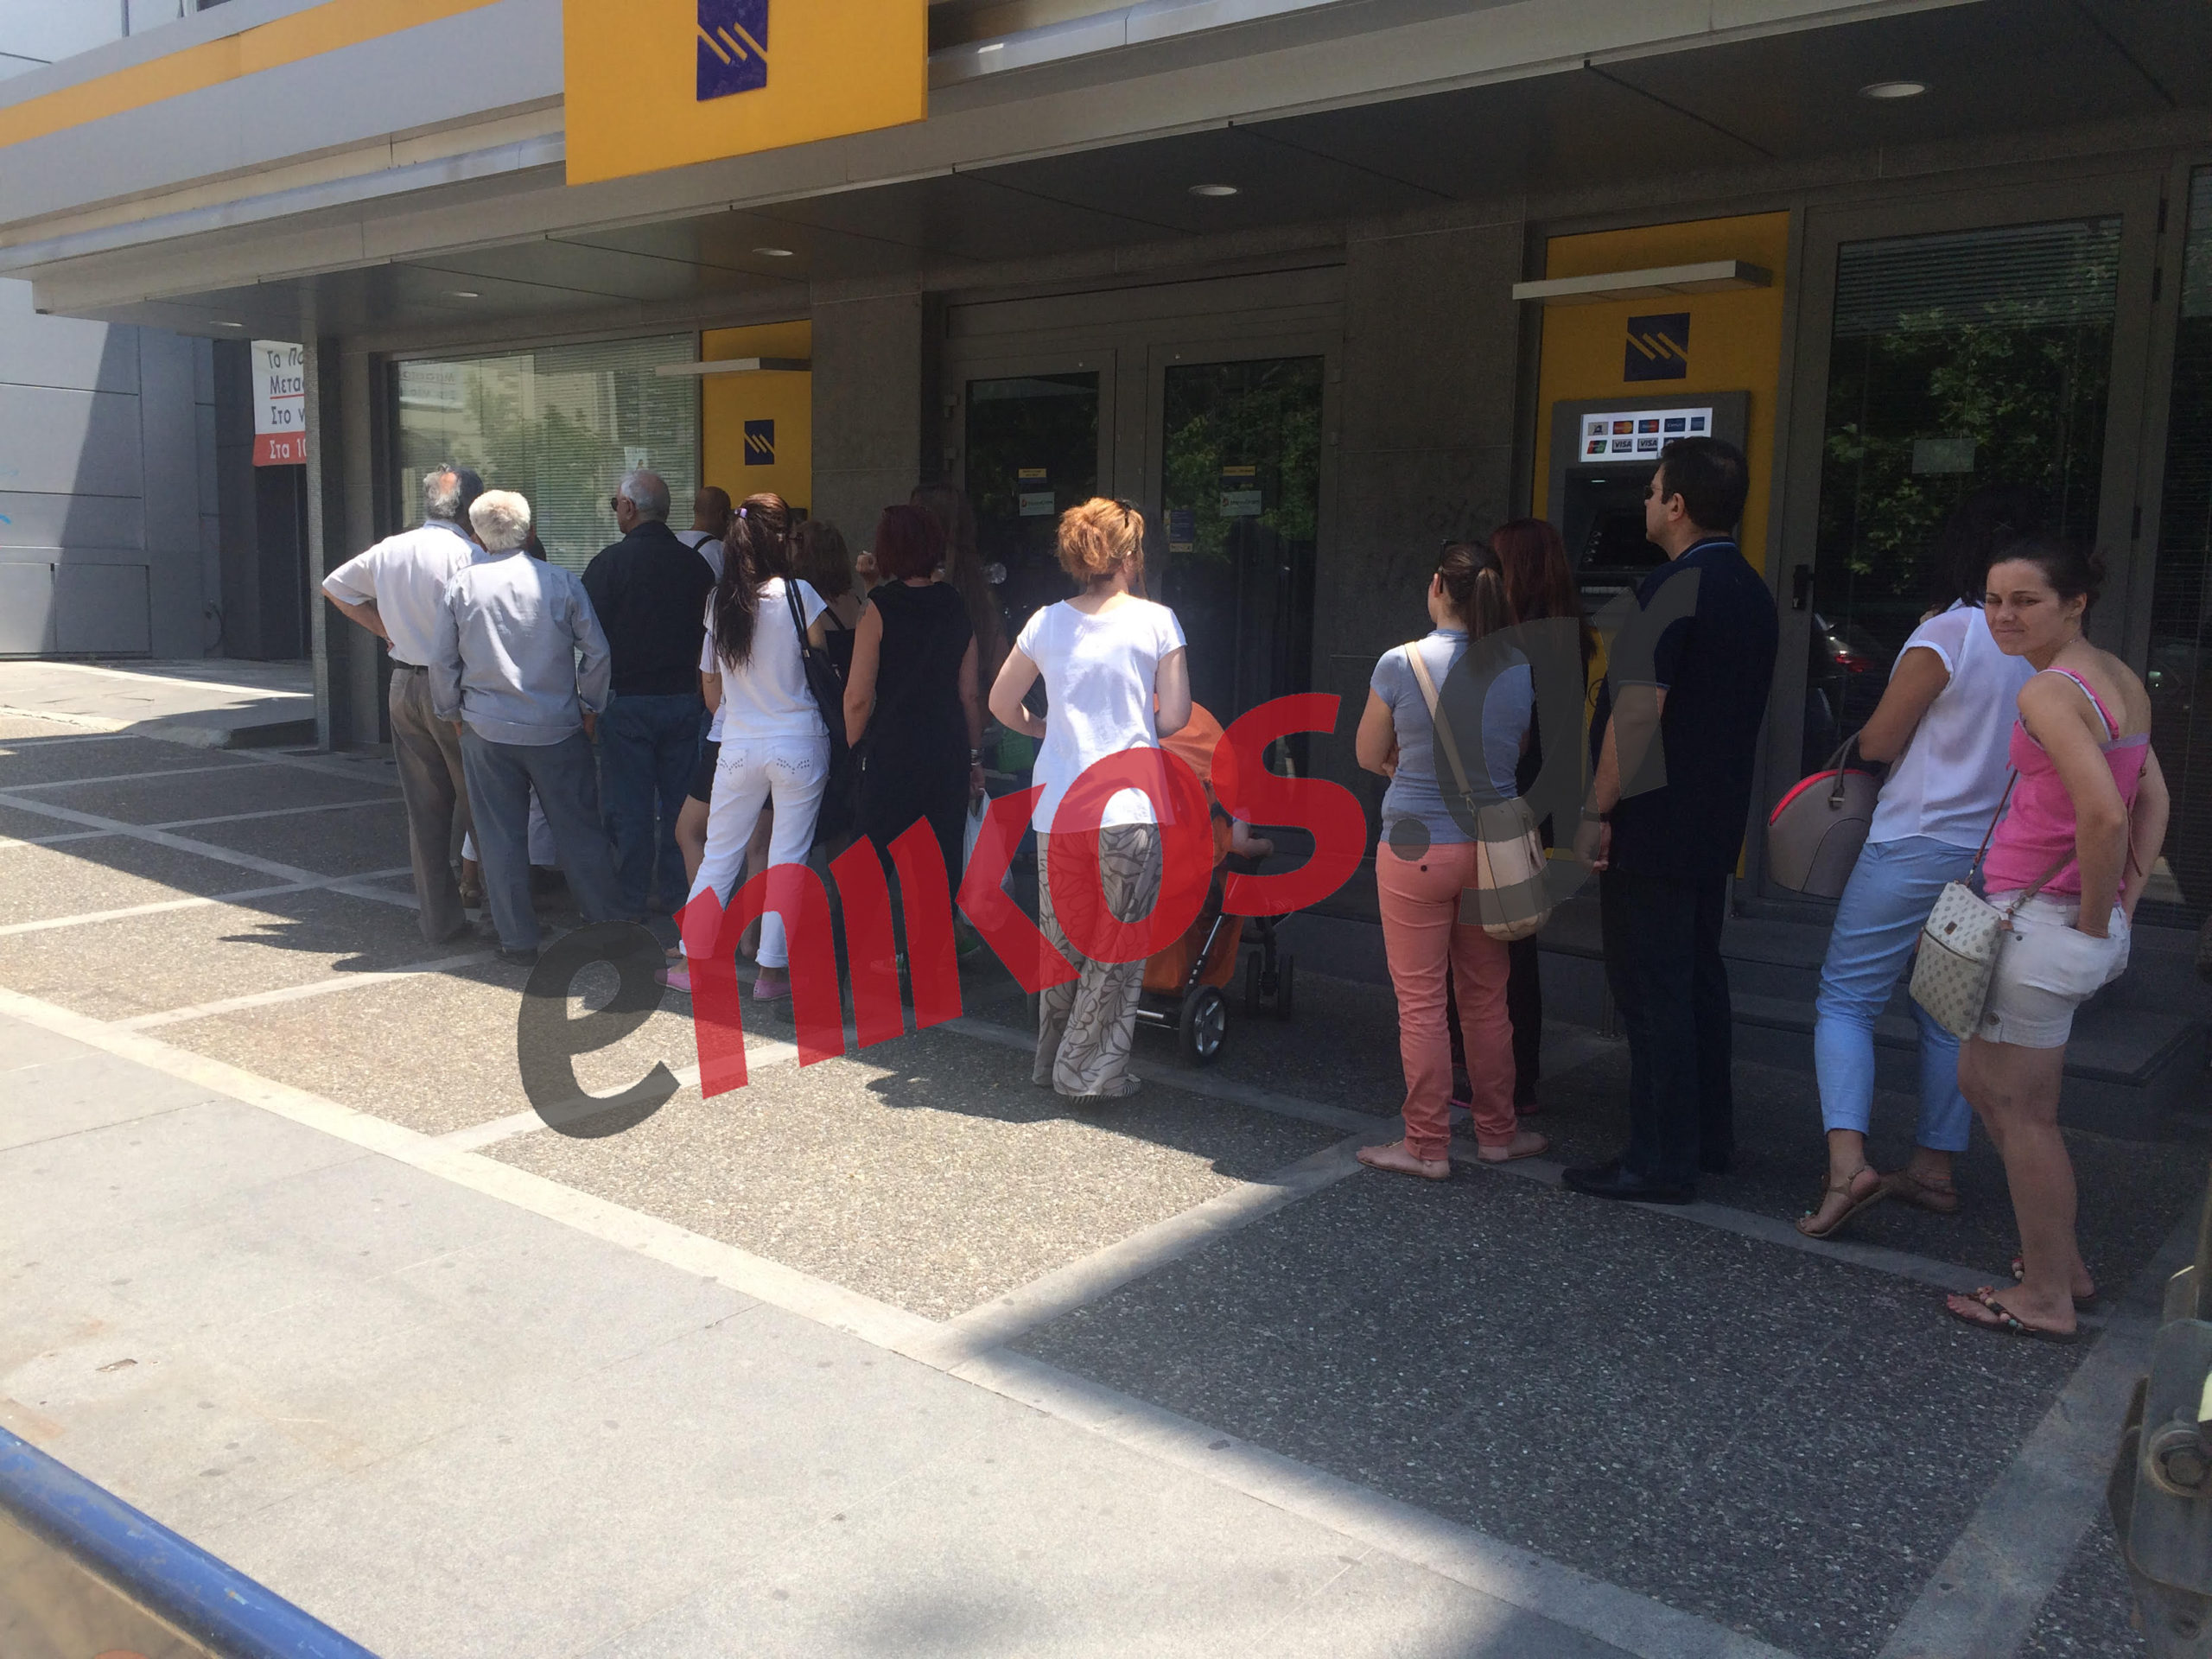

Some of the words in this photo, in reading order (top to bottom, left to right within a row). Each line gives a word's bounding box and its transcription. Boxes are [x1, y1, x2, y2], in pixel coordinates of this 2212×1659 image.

[267, 350, 281, 369] Το
[270, 375, 304, 395] Μετα
[271, 406, 291, 424] Στο
[270, 440, 289, 459] Στα
